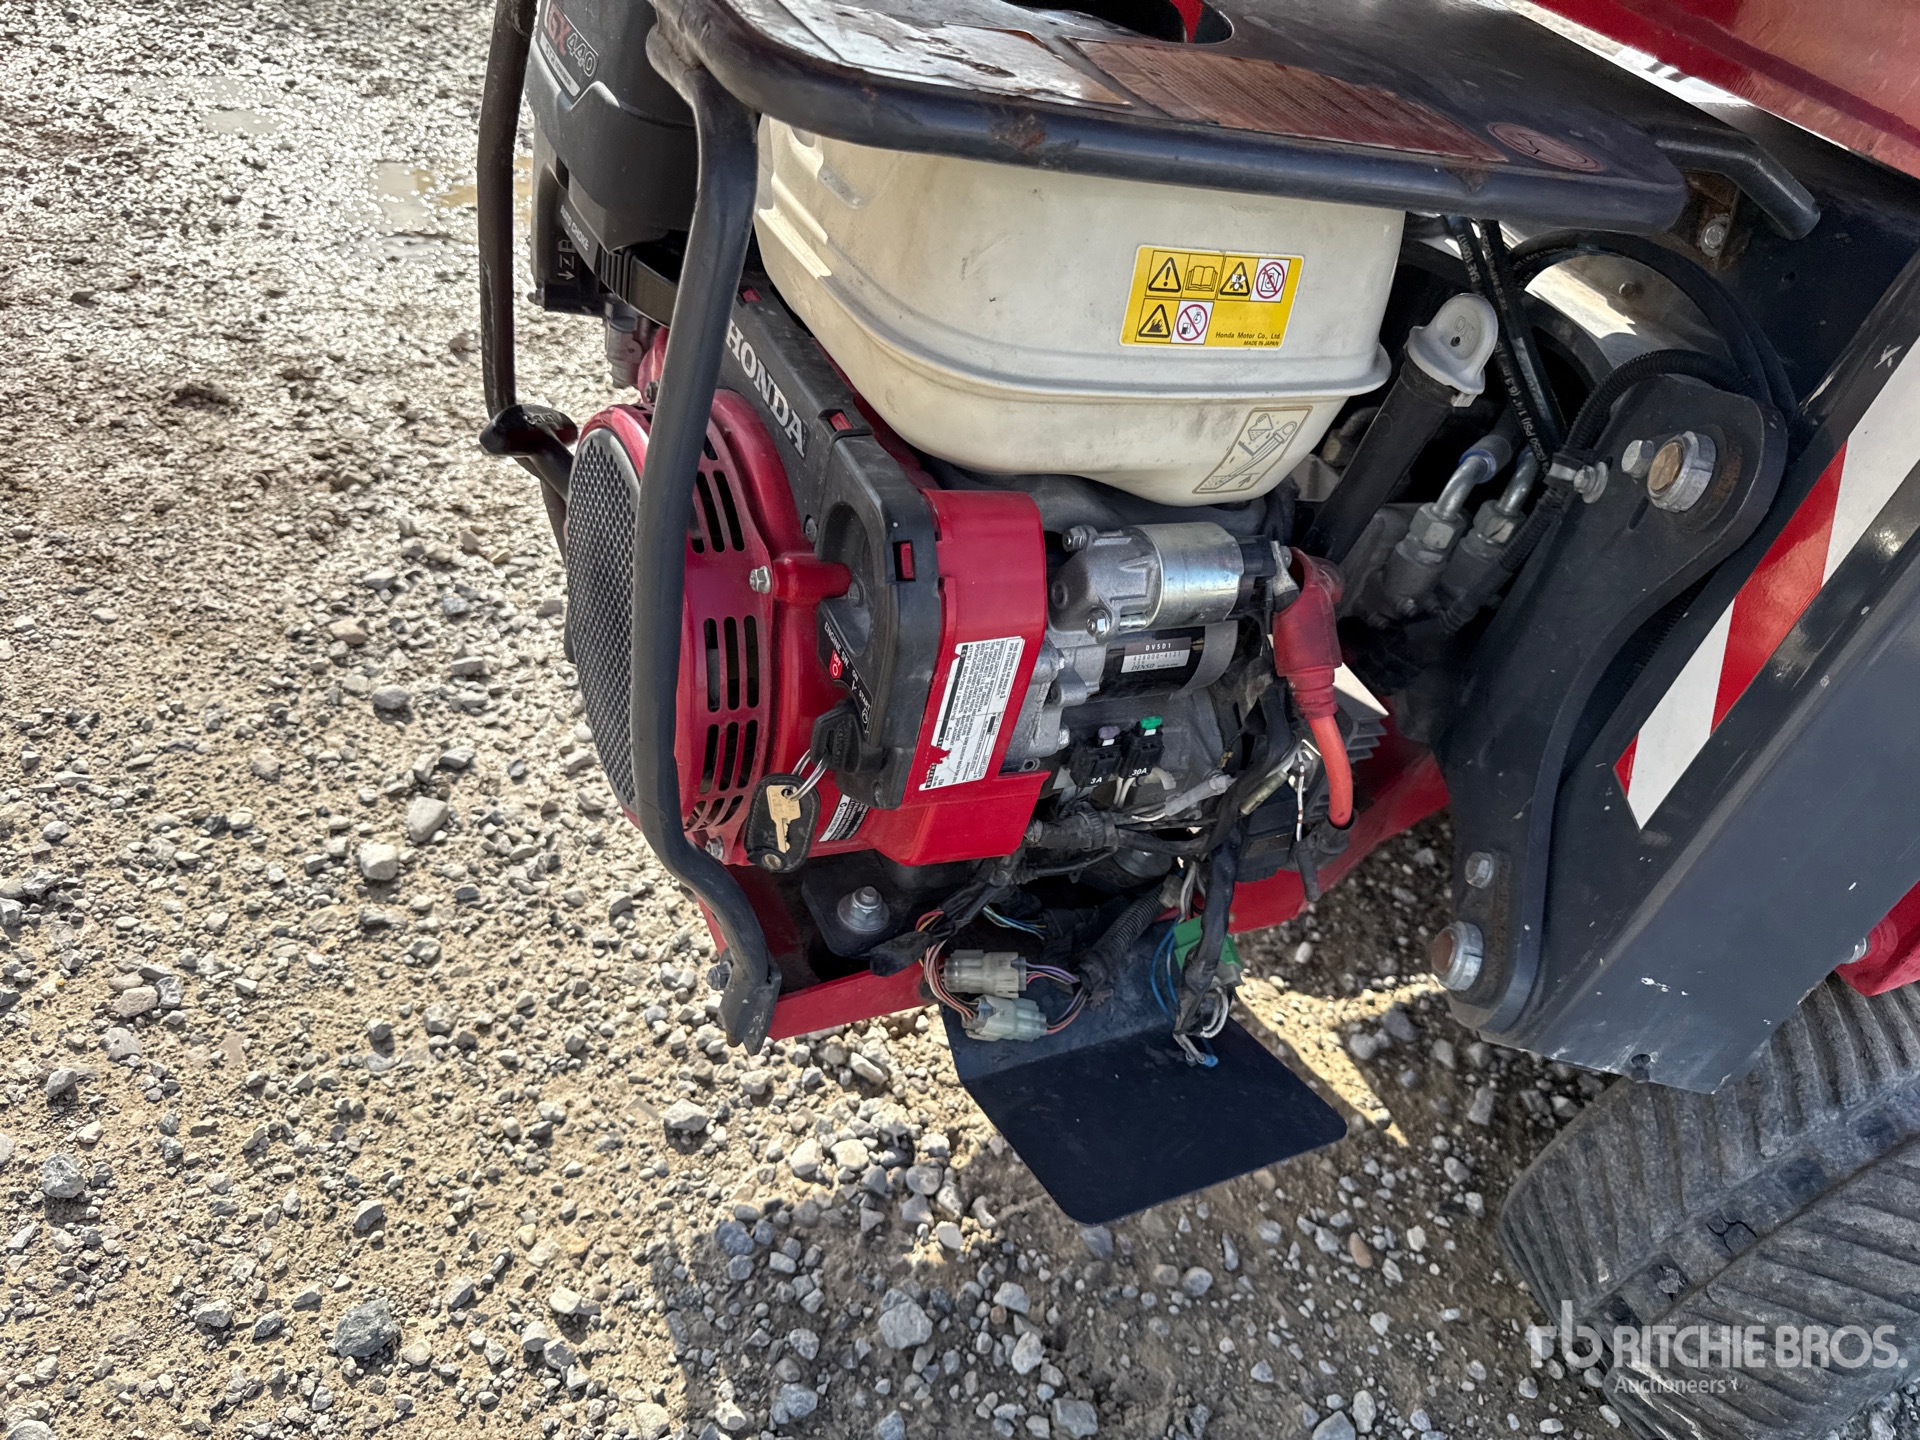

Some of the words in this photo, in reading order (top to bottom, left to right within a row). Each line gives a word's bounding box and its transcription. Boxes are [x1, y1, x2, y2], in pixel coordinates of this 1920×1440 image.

[726, 319, 805, 458] HONDA
[1521, 418, 1536, 438] PSI)
[824, 621, 841, 654] ENGINE
[859, 690, 870, 710] START
